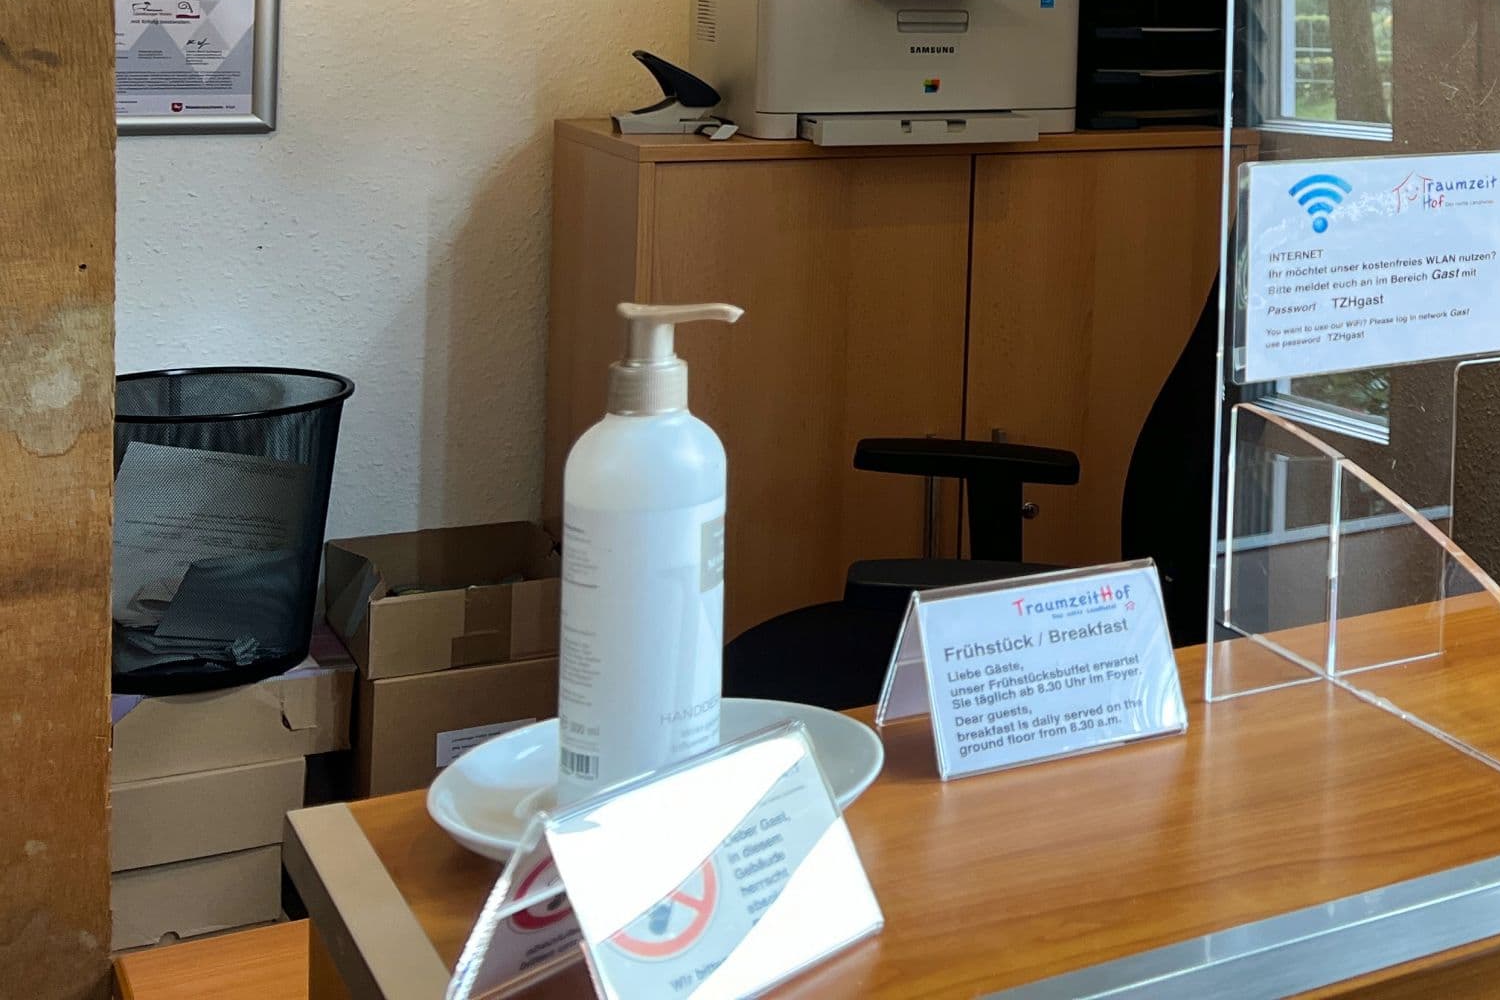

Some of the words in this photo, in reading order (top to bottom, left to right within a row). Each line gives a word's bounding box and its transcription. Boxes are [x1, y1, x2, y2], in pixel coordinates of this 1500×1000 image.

[910, 46, 955, 54] SAMSUNG
[1417, 175, 1498, 194] Traumzeit
[1423, 194, 1445, 210] Hof
[1269, 249, 1324, 263] INTERNET
[1269, 270, 1283, 280] Ihr
[1285, 266, 1328, 278] möchtet
[1330, 264, 1359, 273] unser
[1362, 257, 1423, 271] kostenfreies
[1426, 255, 1457, 265] WLAN
[1458, 251, 1497, 263] nutzen?
[1268, 285, 1292, 295] Bitte
[1295, 282, 1330, 293] meldet
[1332, 278, 1358, 290] euch
[1360, 279, 1373, 287] an
[1375, 276, 1388, 286] im
[1390, 272, 1428, 284] Bereich
[1431, 268, 1460, 280] Gast
[1461, 268, 1477, 278] mit
[1267, 303, 1317, 315] Passwort
[1331, 293, 1385, 310] TZHgast
[1369, 316, 1394, 326] Please
[1396, 314, 1408, 325] log
[1450, 308, 1470, 318] Gast
[1328, 331, 1365, 343] TZHgast
[1012, 584, 1131, 616] TraumzeitHof
[943, 633, 1034, 662] Frühstück
[1050, 618, 1129, 644] Breakfast
[947, 668, 982, 683] Liebe
[985, 661, 1025, 676] Gäste,
[950, 684, 986, 697] unser
[989, 663, 1090, 689] Frühstücksbuffet
[1093, 654, 1140, 670] erwartet
[952, 699, 972, 710] Sie
[975, 688, 1016, 707] täglich
[1019, 687, 1034, 698] ab
[1037, 681, 1062, 694] 8.30
[1065, 675, 1086, 689] Uhr
[1089, 673, 1103, 684] im
[1107, 667, 1143, 683] Foyer.
[955, 713, 984, 727] Dear
[987, 705, 1033, 722] guests,
[957, 723, 1015, 742] breakfast
[1018, 719, 1029, 730] is
[1032, 713, 1060, 730] daily
[1064, 705, 1104, 722] served
[1107, 704, 1122, 713] on
[959, 739, 1004, 758] ground
[1007, 731, 1035, 746] floor
[1039, 725, 1067, 739] from
[1070, 720, 1094, 732] 8.30
[1097, 716, 1122, 728] a.m.
